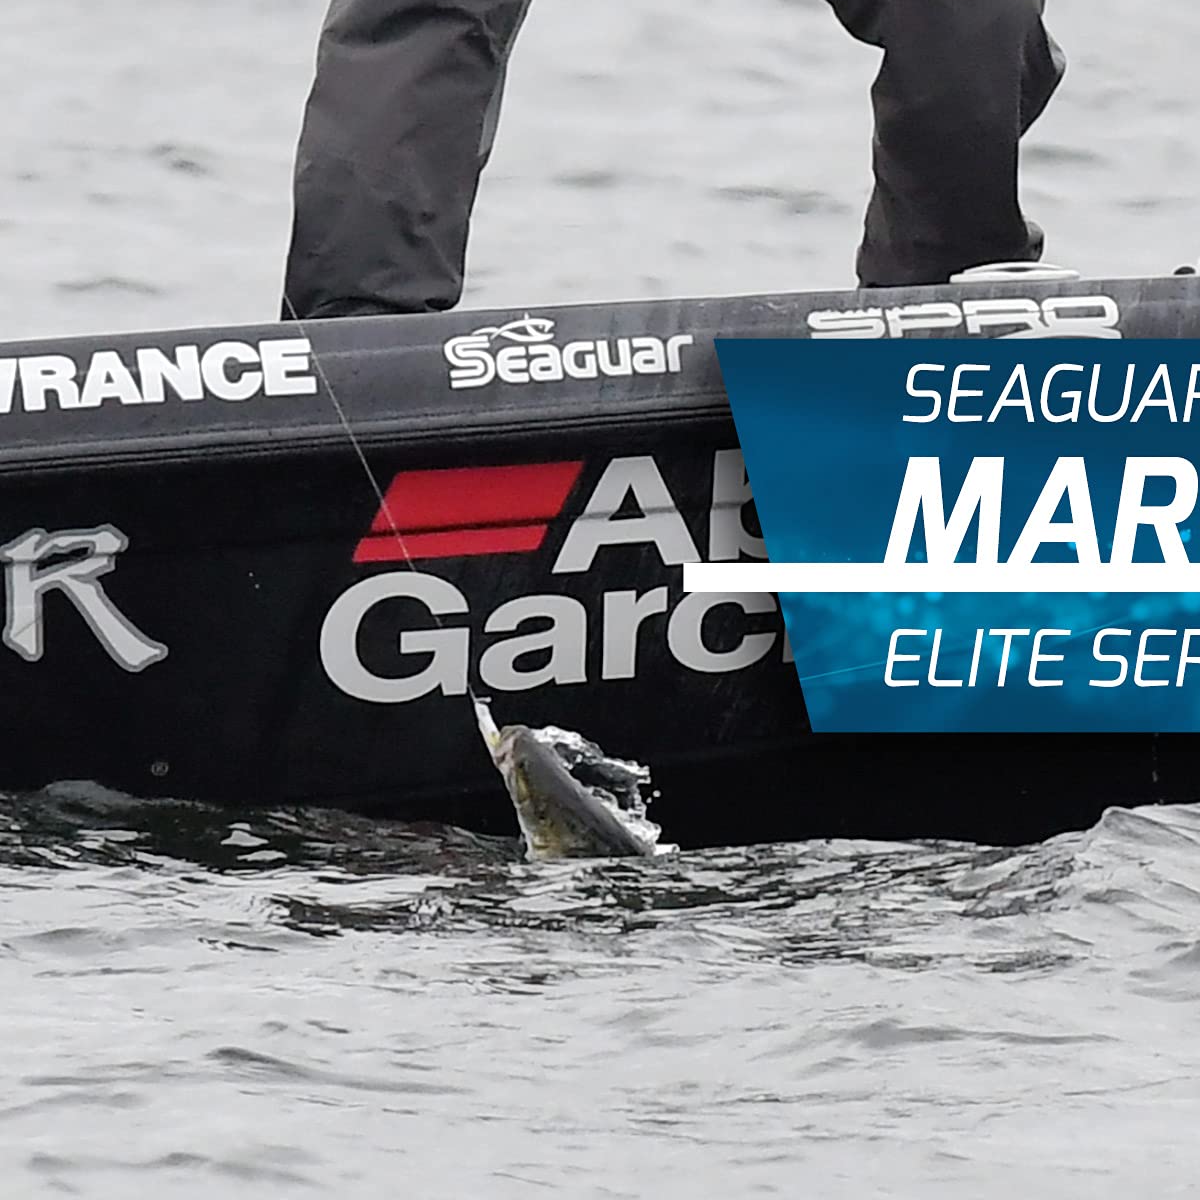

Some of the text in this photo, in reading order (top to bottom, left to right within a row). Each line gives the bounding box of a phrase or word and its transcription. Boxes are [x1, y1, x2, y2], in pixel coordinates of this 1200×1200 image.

[807, 296, 1121, 339] SPRO
[0, 338, 318, 413] RANCE
[443, 333, 693, 389] Seaguar
[319, 571, 795, 704] Garc
